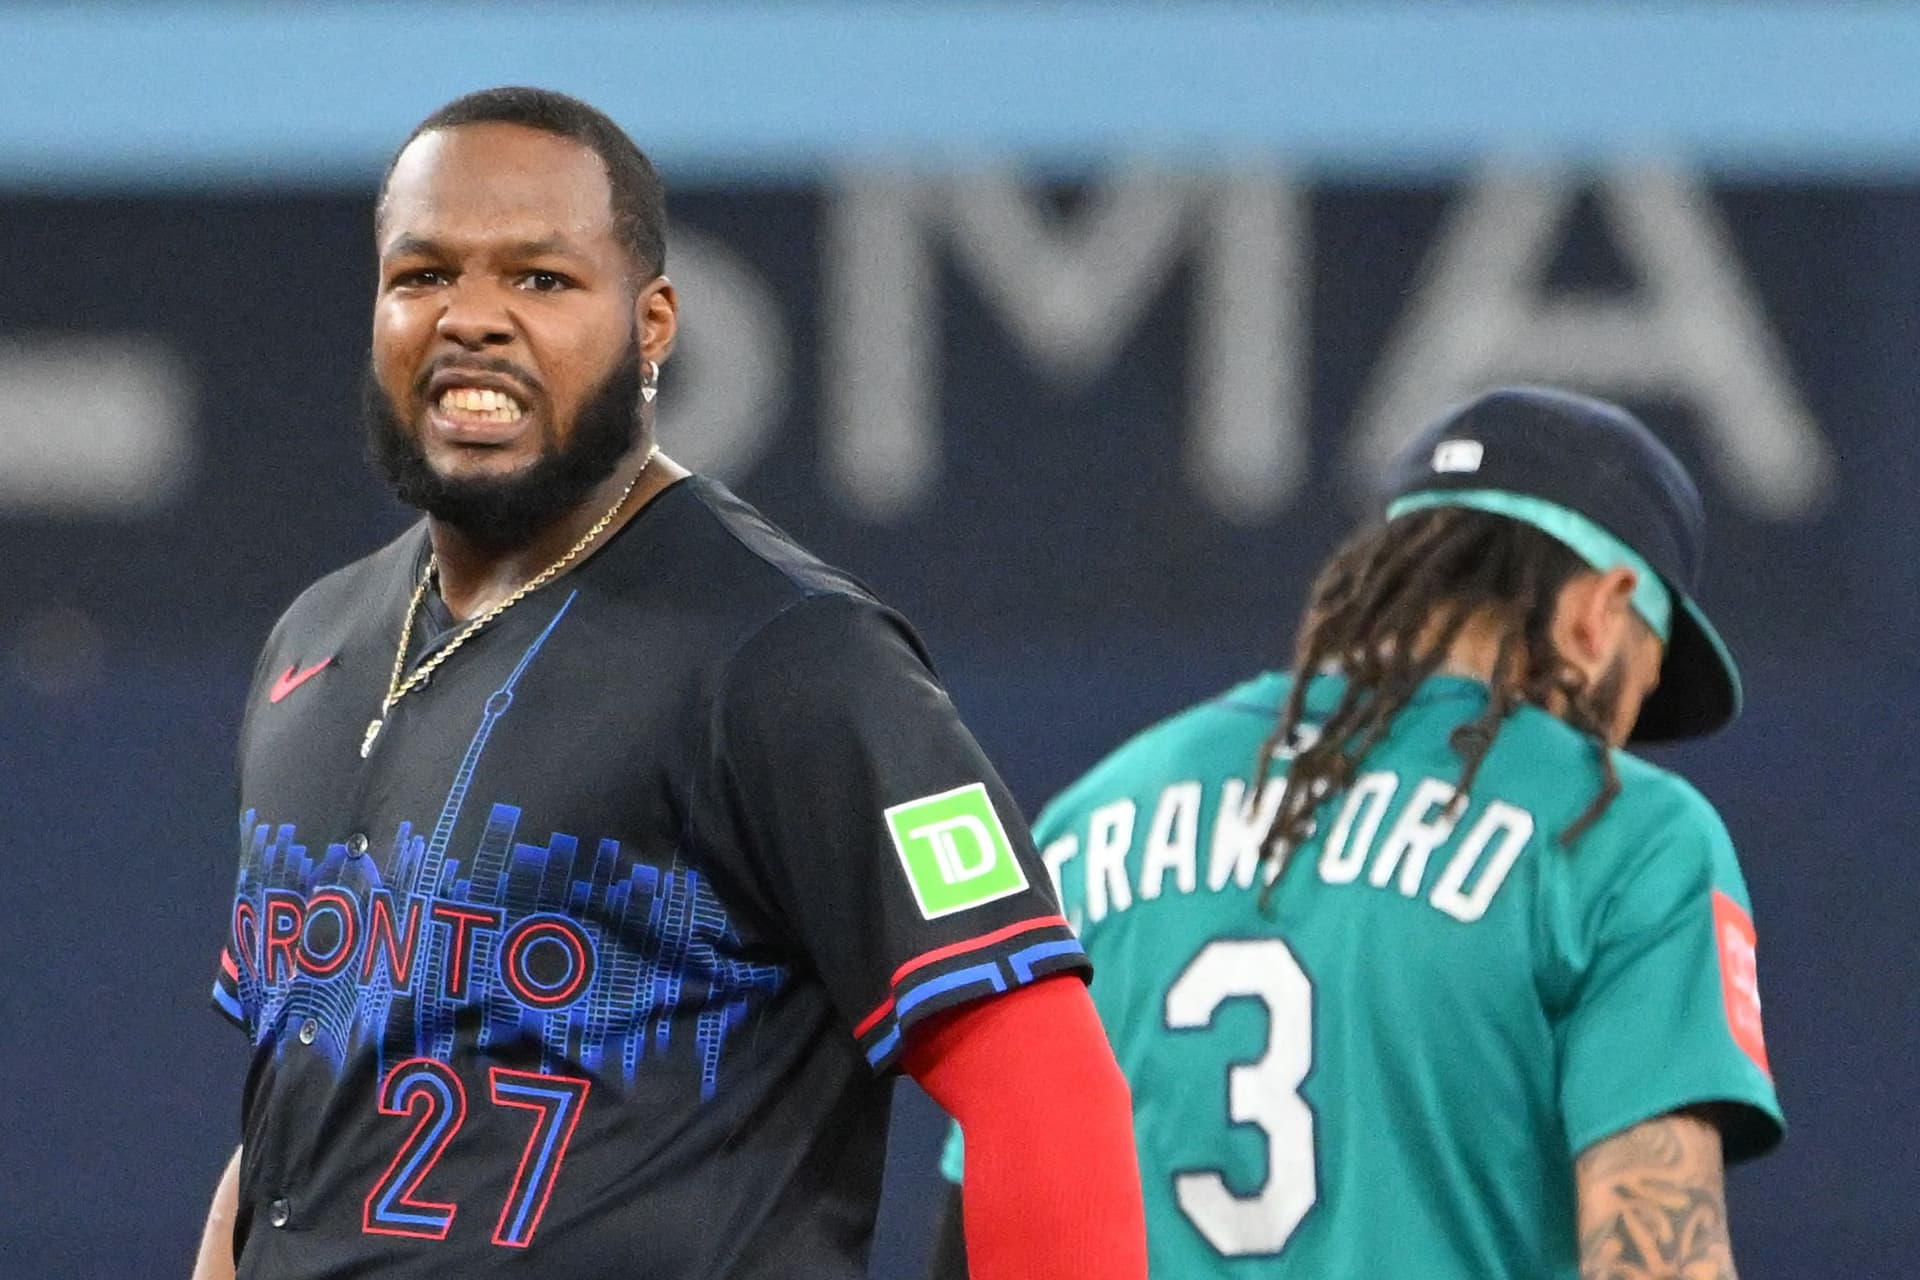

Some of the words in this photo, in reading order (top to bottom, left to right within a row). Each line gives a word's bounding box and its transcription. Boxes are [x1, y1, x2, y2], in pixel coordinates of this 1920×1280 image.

[907, 813, 998, 886] TD
[1040, 769, 1536, 936] CRAWORD
[232, 885, 599, 1012] ORONTO
[362, 1056, 592, 1248] 27
[1163, 936, 1318, 1258] 3
